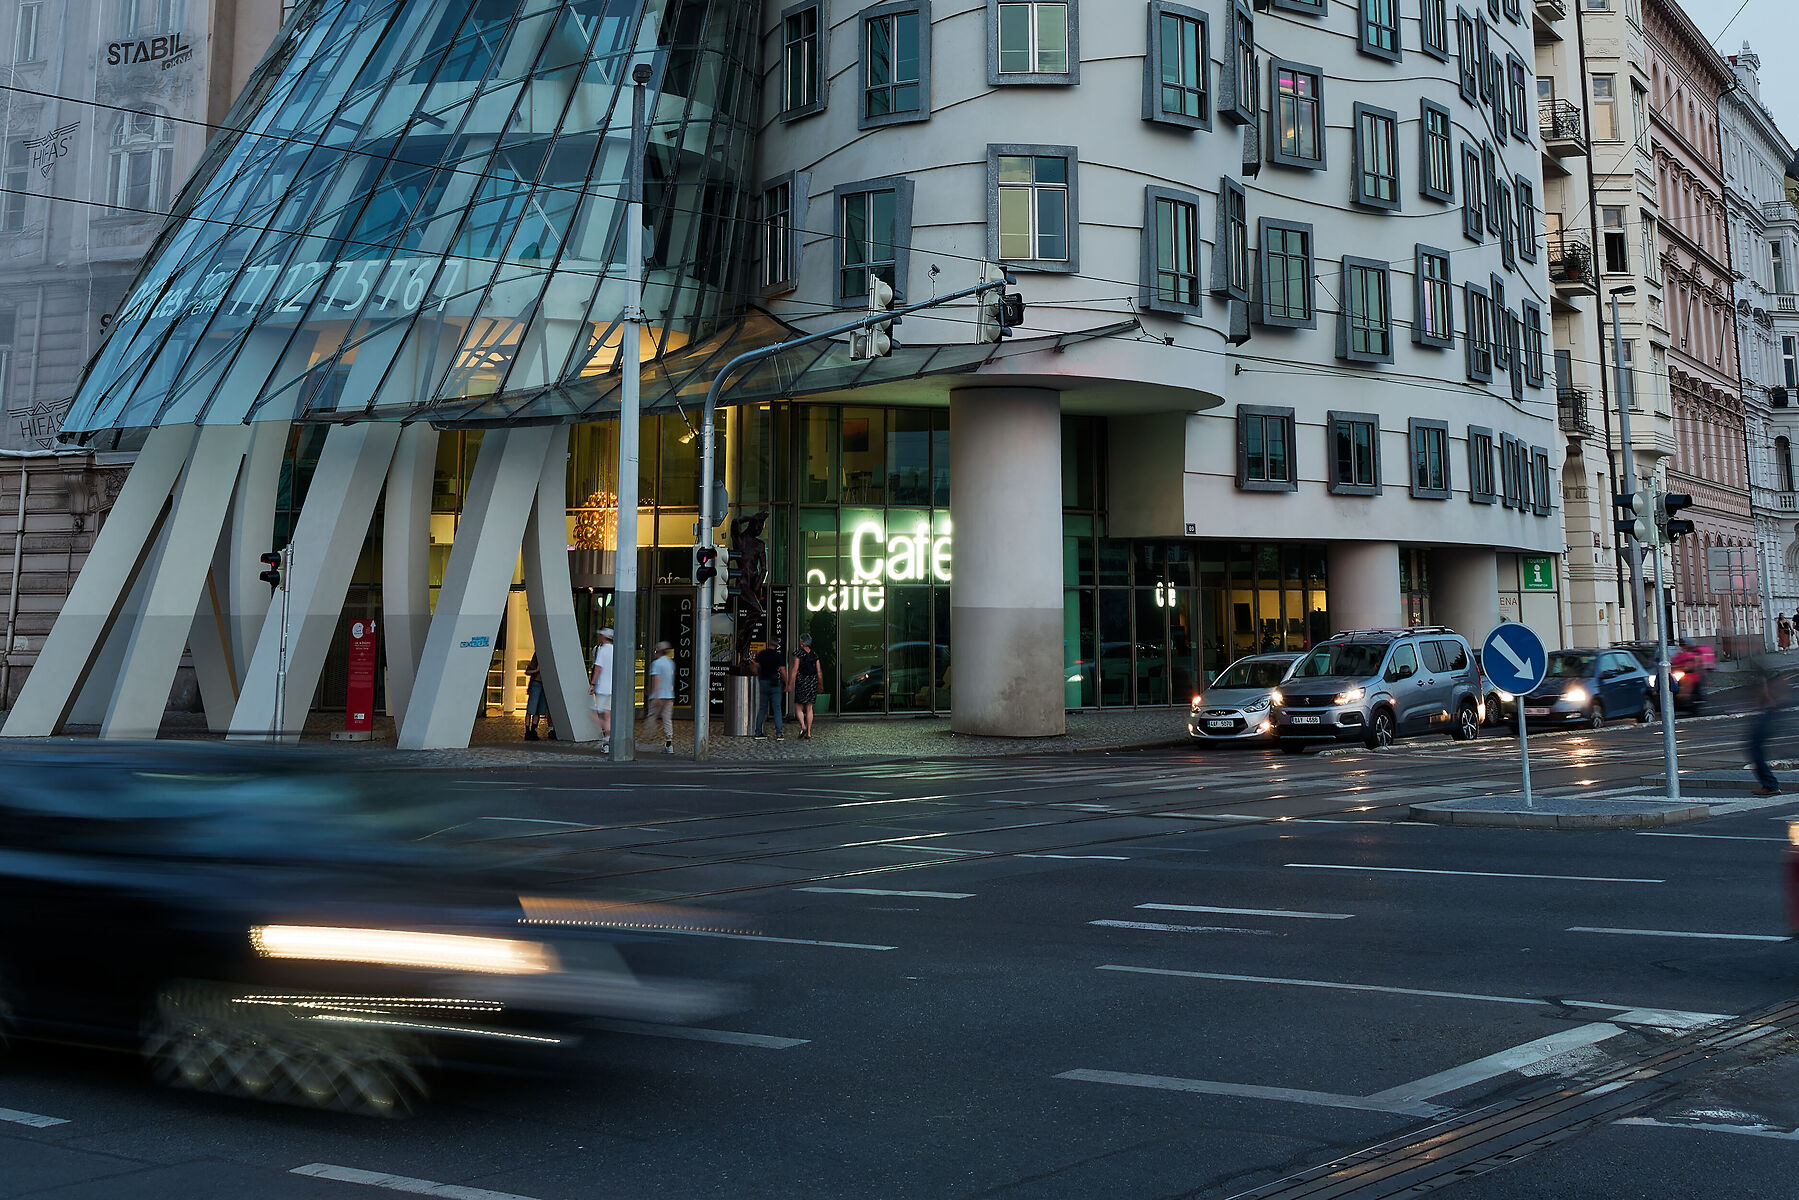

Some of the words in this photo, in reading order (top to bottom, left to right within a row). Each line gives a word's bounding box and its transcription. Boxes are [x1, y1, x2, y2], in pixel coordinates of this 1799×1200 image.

[107, 32, 189, 66] STABIL
[680, 598, 692, 658] GLASS
[679, 667, 690, 704] BAR
